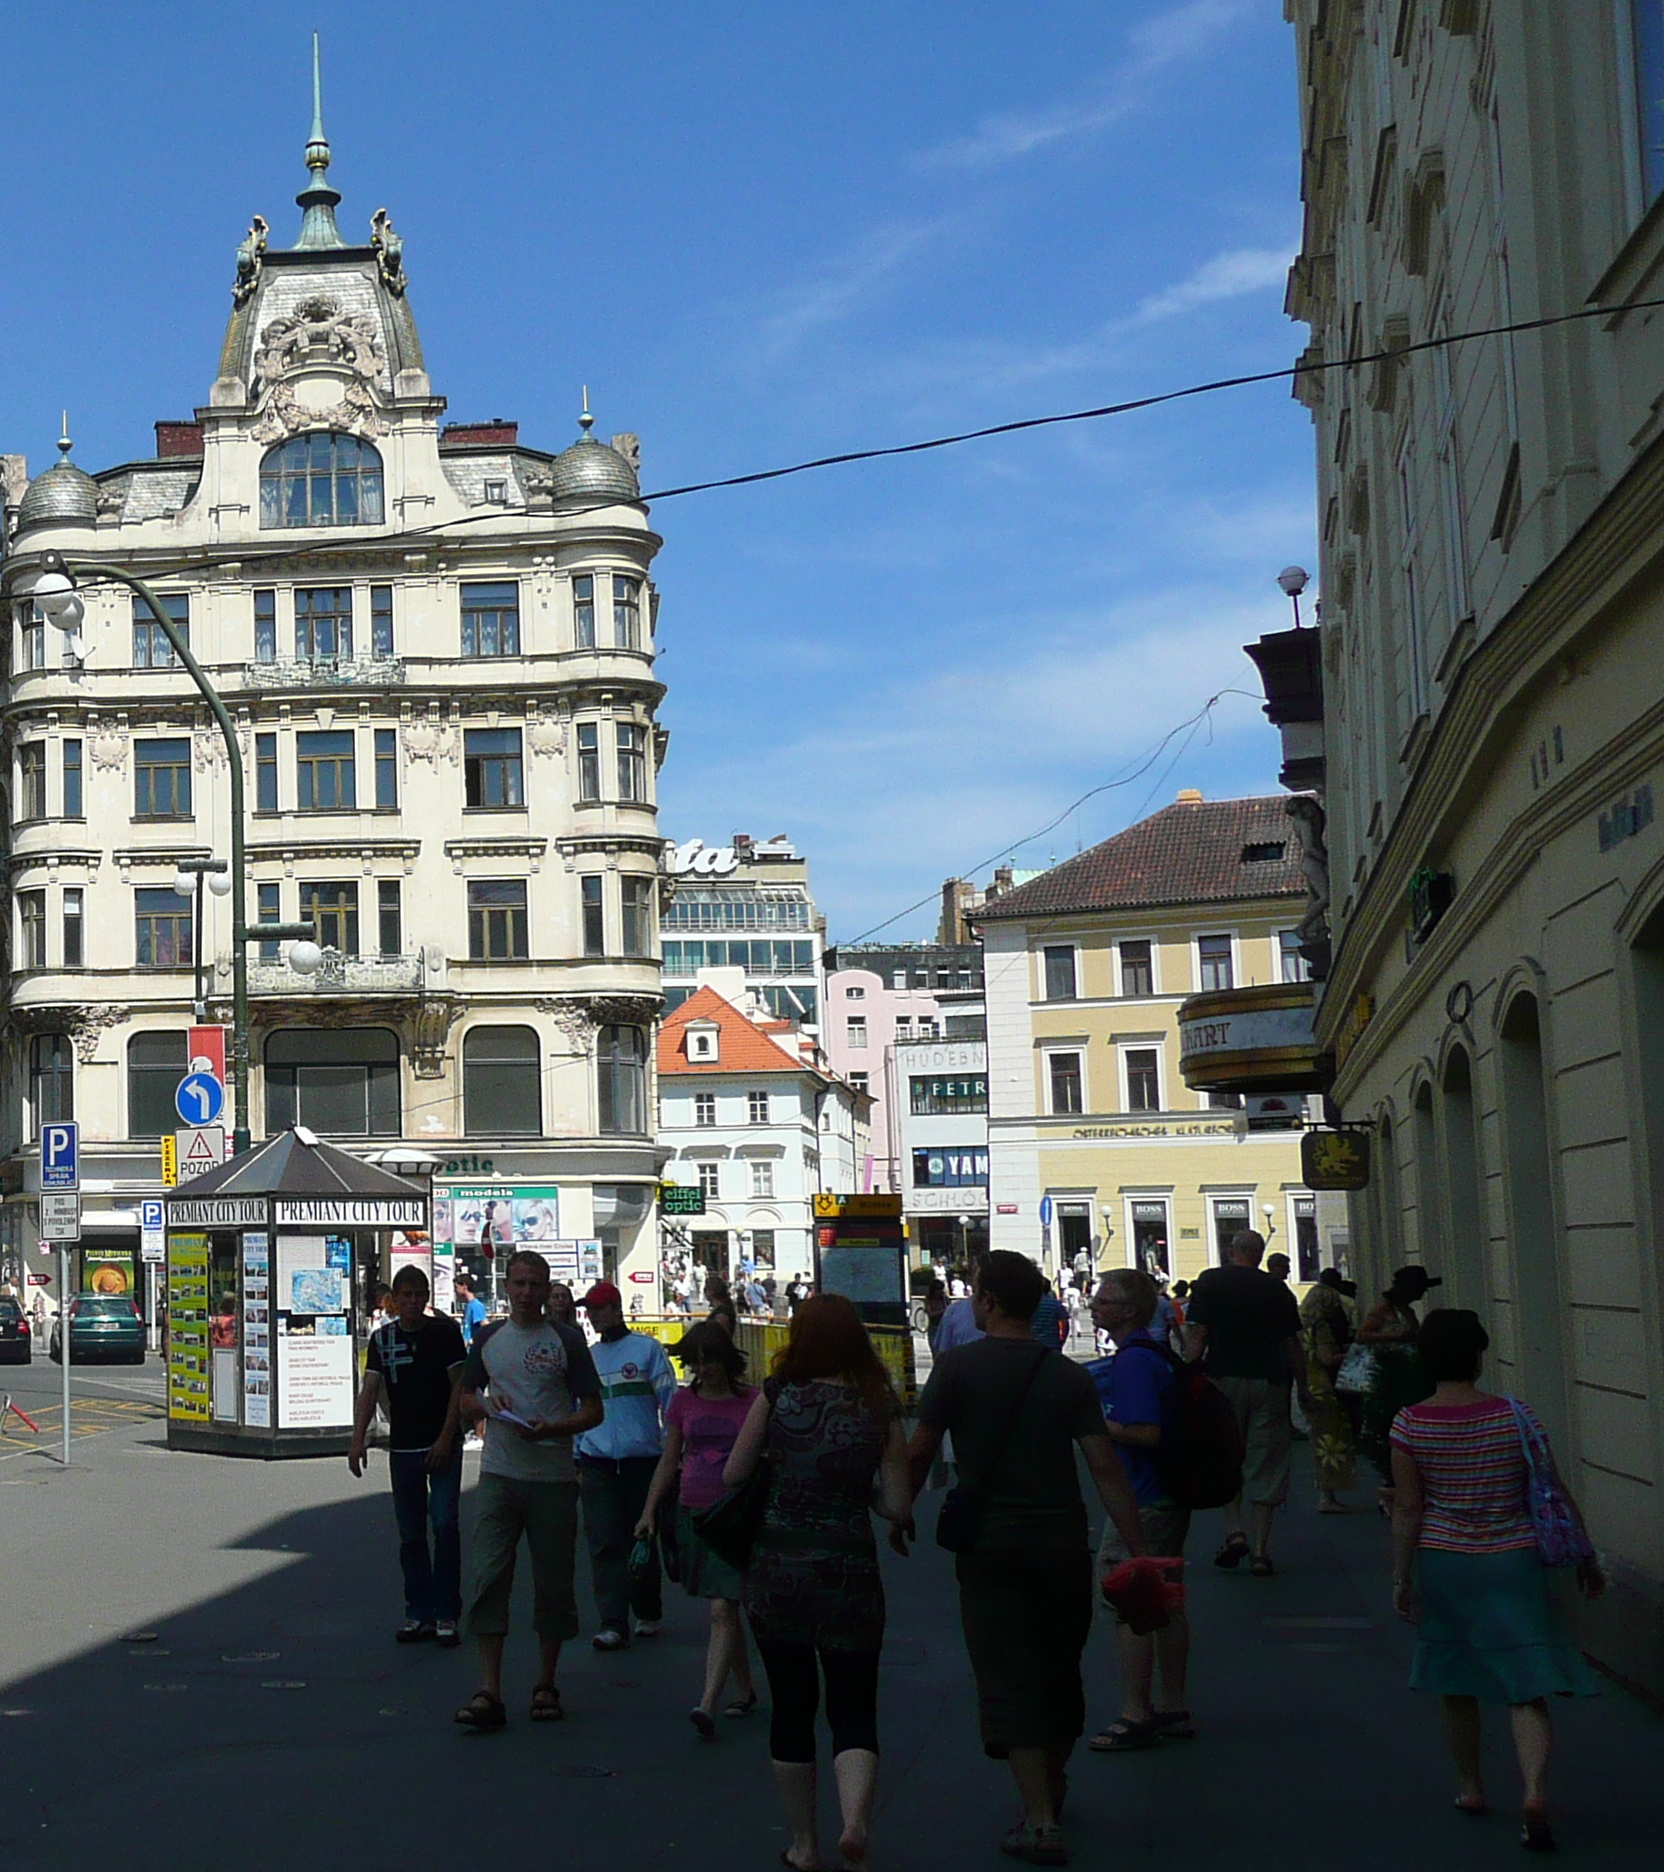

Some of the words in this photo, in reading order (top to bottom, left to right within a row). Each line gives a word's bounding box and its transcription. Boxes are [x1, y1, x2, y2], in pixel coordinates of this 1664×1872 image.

[49, 1128, 69, 1166] P
[948, 1155, 989, 1176] YAM
[459, 1189, 513, 1197] models
[665, 1188, 701, 1200] eiffel
[146, 1205, 159, 1223] P
[170, 1201, 215, 1223] PREMIANT
[216, 1200, 237, 1222] CITY
[240, 1200, 265, 1222] TOUR
[281, 1200, 349, 1222] PREMIANT
[352, 1201, 380, 1222] CITY
[386, 1201, 421, 1222] TOUR
[665, 1200, 702, 1213] optic
[1136, 1205, 1162, 1213] BOSS
[1217, 1204, 1245, 1212] BOSS
